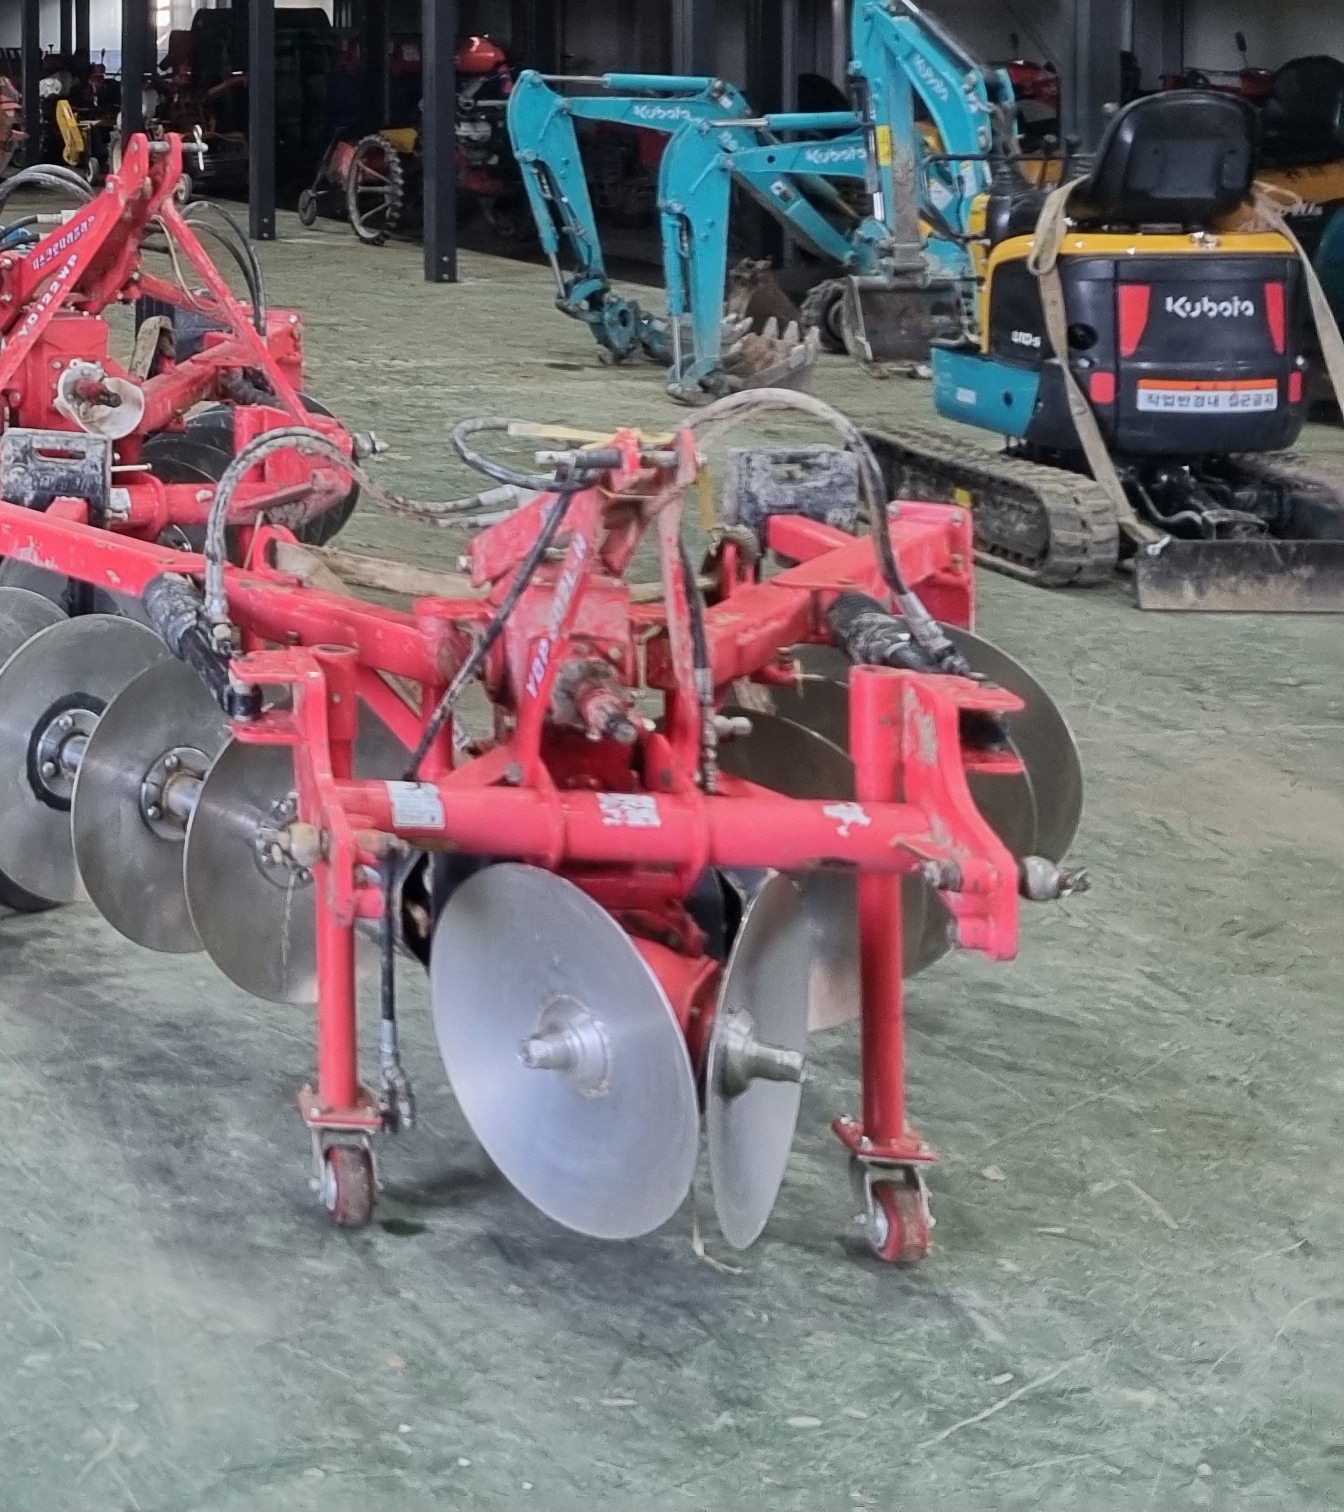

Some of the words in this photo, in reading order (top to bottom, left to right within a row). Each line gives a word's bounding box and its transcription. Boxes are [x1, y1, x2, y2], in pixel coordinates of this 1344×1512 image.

[634, 105, 690, 121] Kubota
[806, 149, 867, 165] Kubota
[18, 253, 79, 337] YD122WP
[1165, 296, 1255, 319] Kubota
